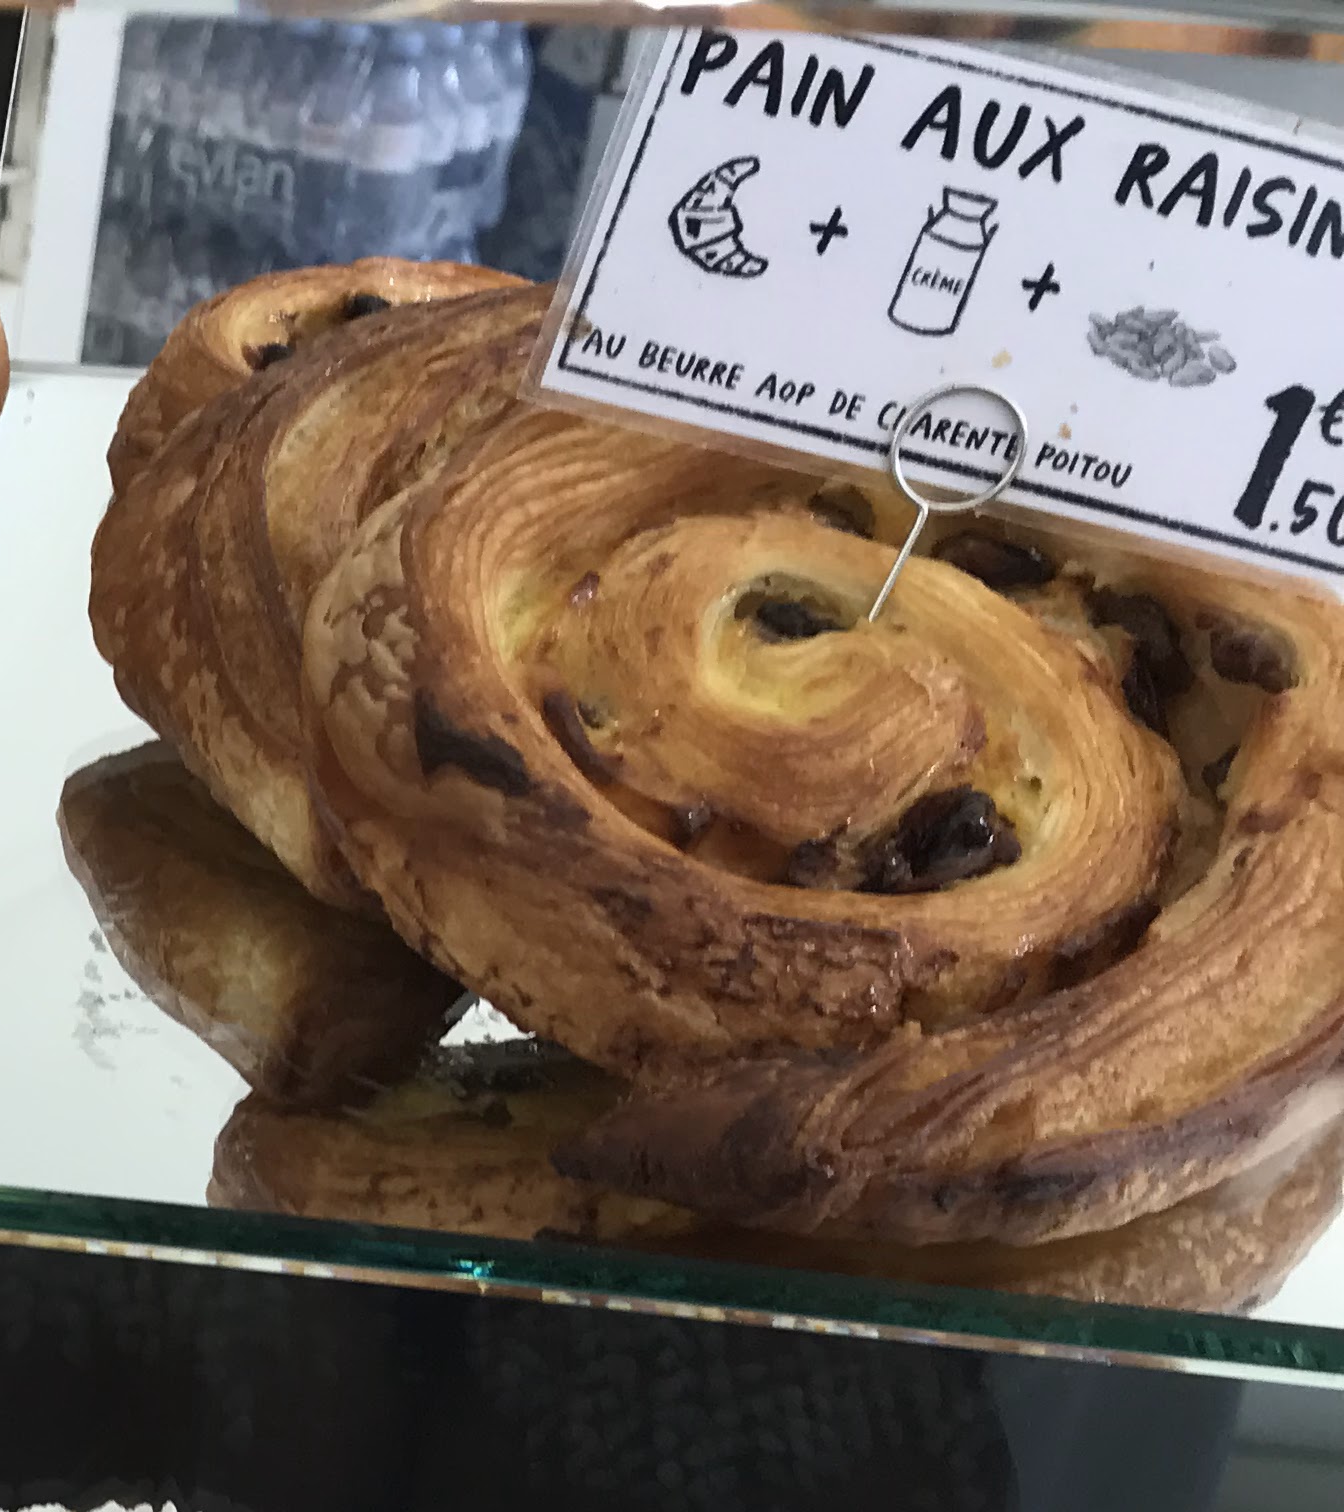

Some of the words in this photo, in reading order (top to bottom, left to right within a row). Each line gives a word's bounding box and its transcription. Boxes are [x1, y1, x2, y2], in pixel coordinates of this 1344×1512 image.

[680, 25, 876, 128] PAIN
[899, 83, 1086, 184] AUX
[581, 327, 627, 360] AU
[638, 338, 745, 391] BEURRE
[755, 371, 816, 407] AOP
[828, 387, 867, 421] DE
[1034, 441, 1134, 489] POITOU
